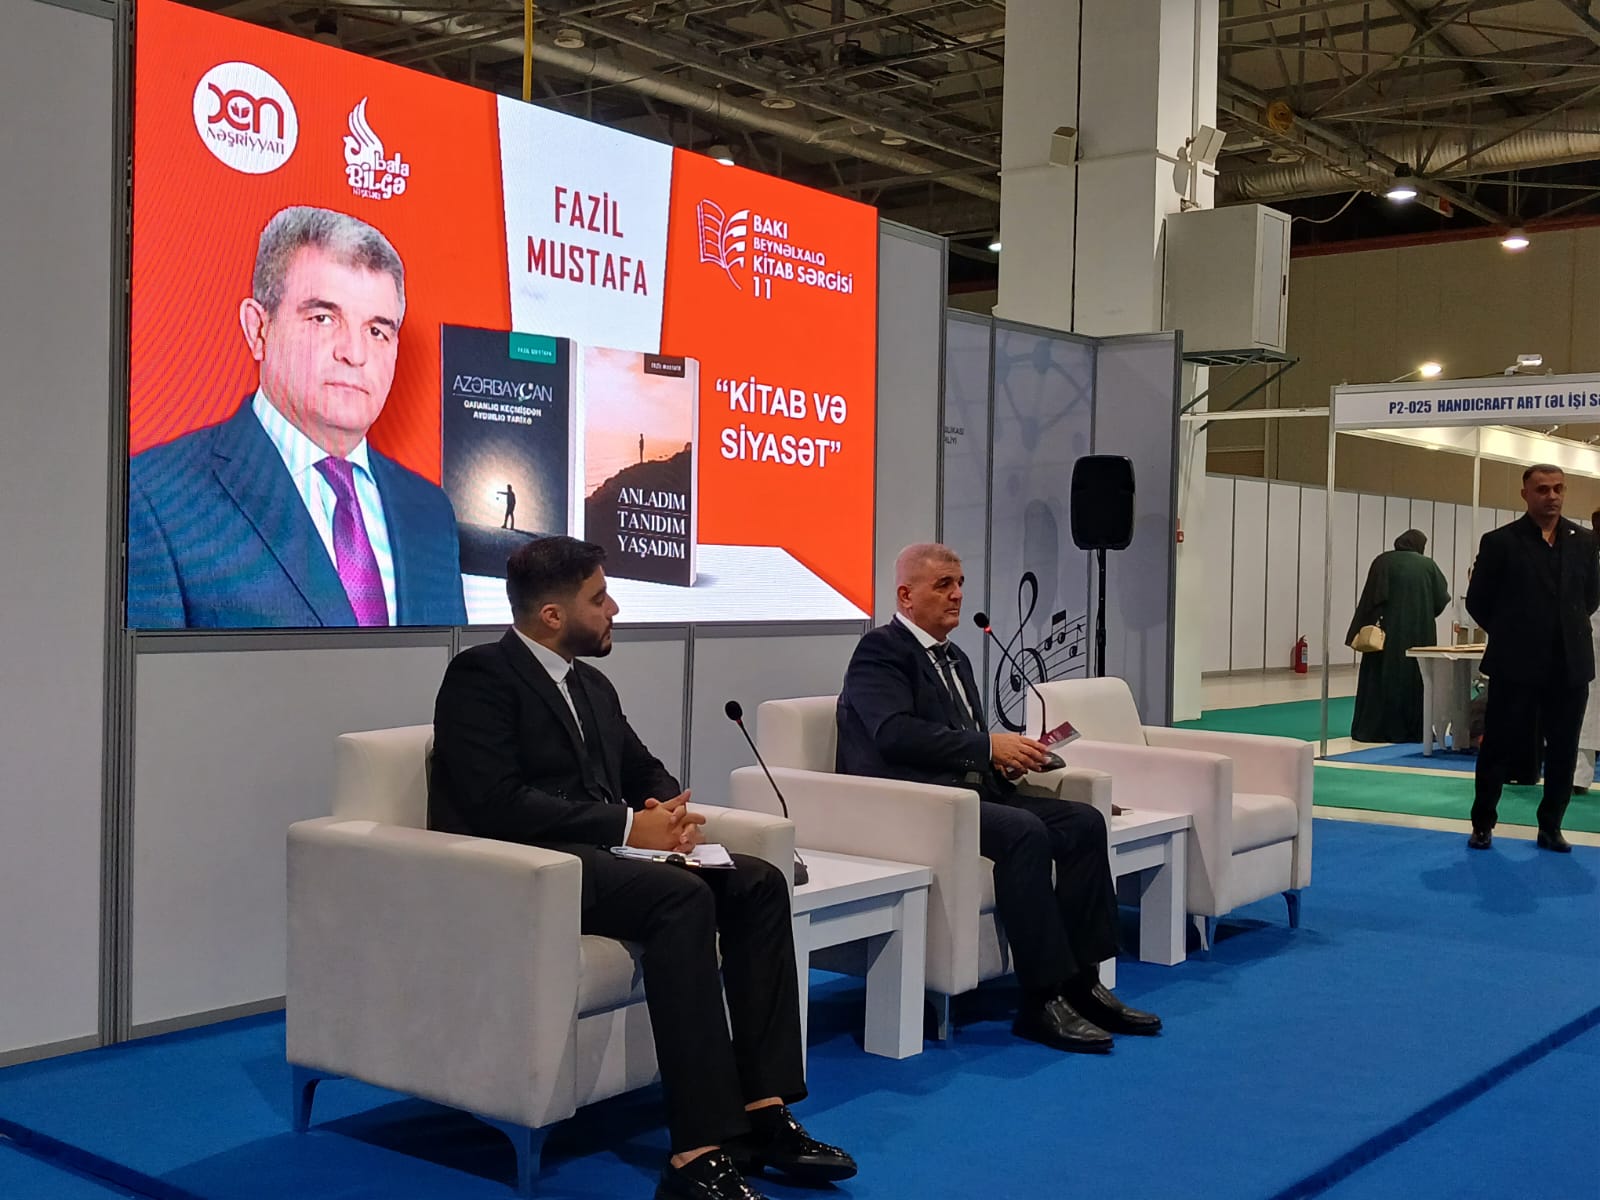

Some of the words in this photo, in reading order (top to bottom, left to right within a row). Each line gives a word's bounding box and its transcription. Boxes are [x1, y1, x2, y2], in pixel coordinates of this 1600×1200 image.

[554, 185, 624, 238] FAZİL
[753, 214, 788, 239] BAKI
[753, 236, 826, 266] BEYNƏLXALQ
[527, 235, 648, 296] MUSTAFA
[753, 253, 795, 280] KİTAB
[797, 266, 853, 294] SƏRGİSİ
[753, 275, 772, 300] 11
[452, 374, 553, 402] AZƏRBAYCAN
[715, 376, 807, 420] “KİTAB
[813, 392, 847, 424] VƏ
[1389, 400, 1432, 414] P2-025
[1437, 396, 1514, 413] HANDICRAFT
[1516, 395, 1542, 410] ART
[1544, 394, 1565, 409] (ƏL
[1568, 391, 1586, 410] İŞİ
[720, 423, 841, 468] SİYASƏT”
[617, 487, 686, 511] ANLADIM
[616, 510, 686, 536] TANIDIM
[616, 534, 686, 560] YAŞADIM
